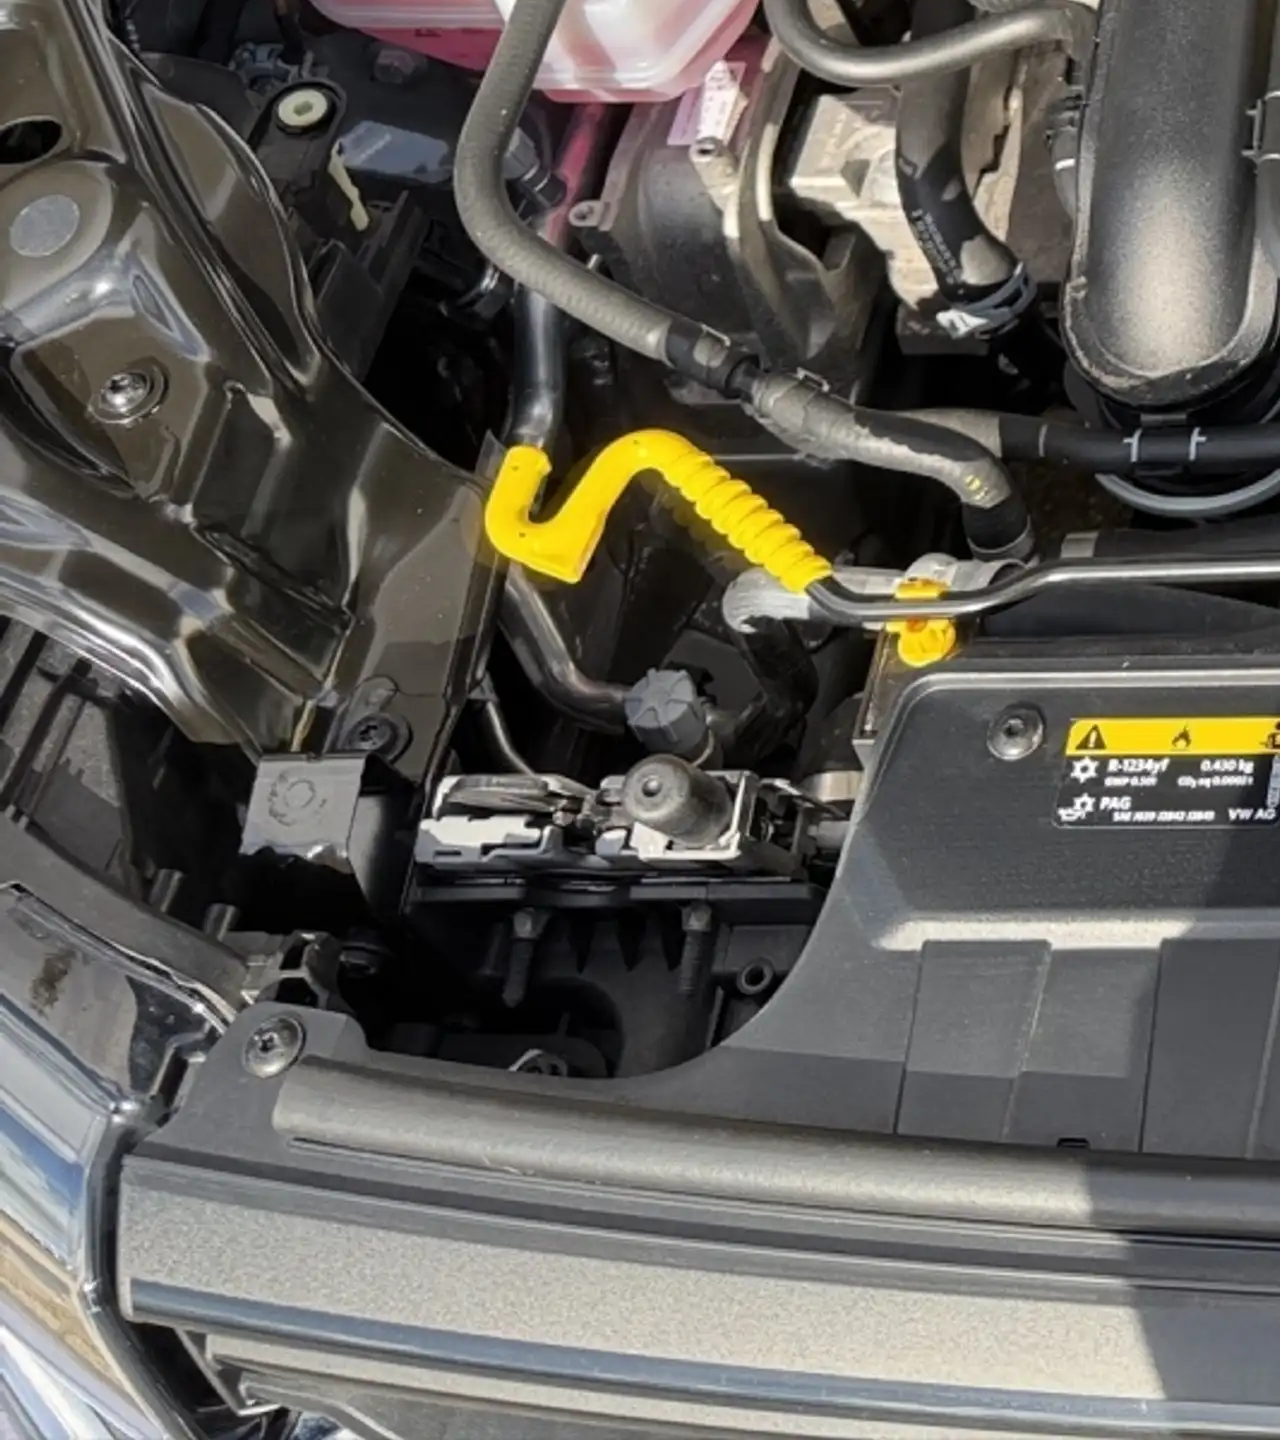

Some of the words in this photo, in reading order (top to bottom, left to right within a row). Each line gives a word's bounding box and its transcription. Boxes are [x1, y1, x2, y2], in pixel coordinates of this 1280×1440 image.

[1238, 758, 1255, 774] kg
[1100, 796, 1132, 811] PAG
[1228, 807, 1254, 821] VW
[1255, 807, 1277, 821] AG
